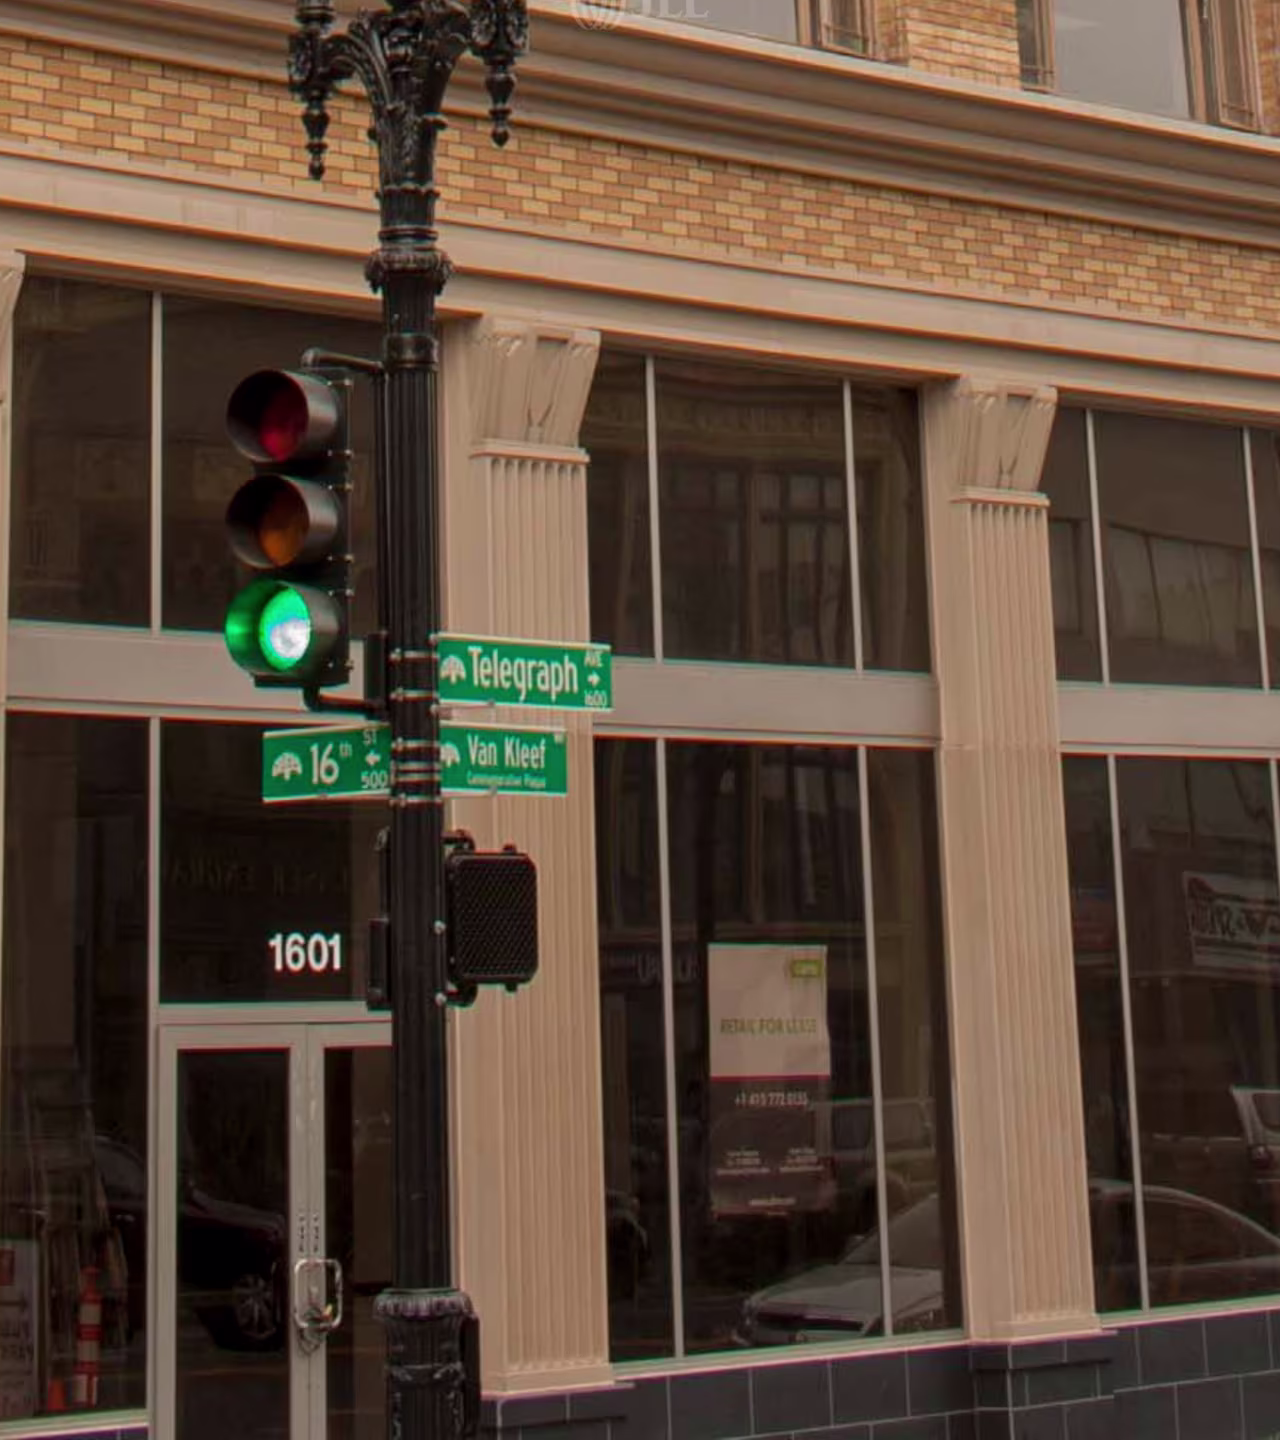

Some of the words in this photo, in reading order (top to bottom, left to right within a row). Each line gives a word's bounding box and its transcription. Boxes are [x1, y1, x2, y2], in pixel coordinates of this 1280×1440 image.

[467, 645, 579, 703] Telegraph
[584, 650, 603, 668] AVE
[584, 690, 607, 707] 1600
[363, 728, 377, 747] ST
[467, 733, 497, 766] Van
[503, 736, 546, 769] Kleef
[361, 770, 389, 789] 500
[268, 932, 341, 972] 1601
